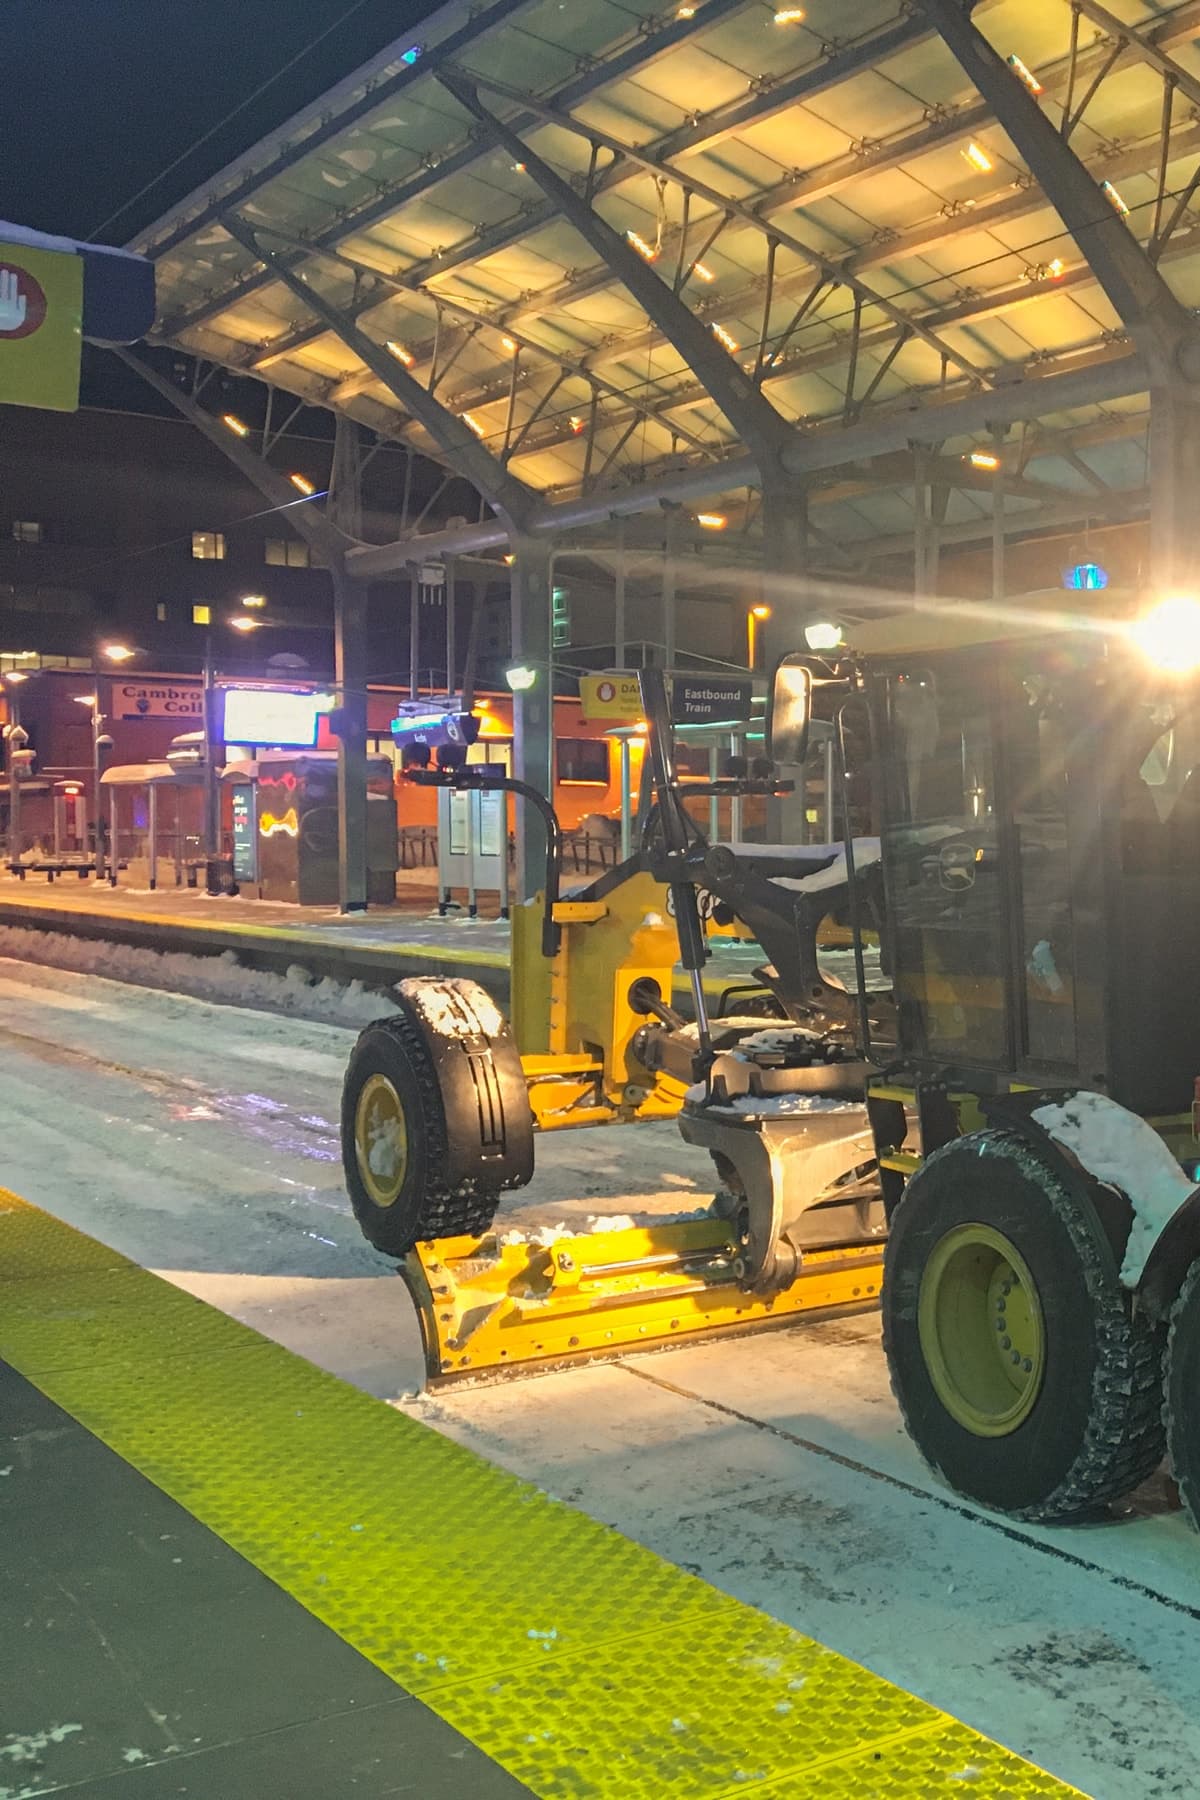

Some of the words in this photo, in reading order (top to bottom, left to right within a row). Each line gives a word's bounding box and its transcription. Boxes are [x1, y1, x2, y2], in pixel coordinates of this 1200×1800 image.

[122, 686, 201, 700] Cambro
[685, 689, 741, 701] Eastbound
[685, 703, 711, 713] Train
